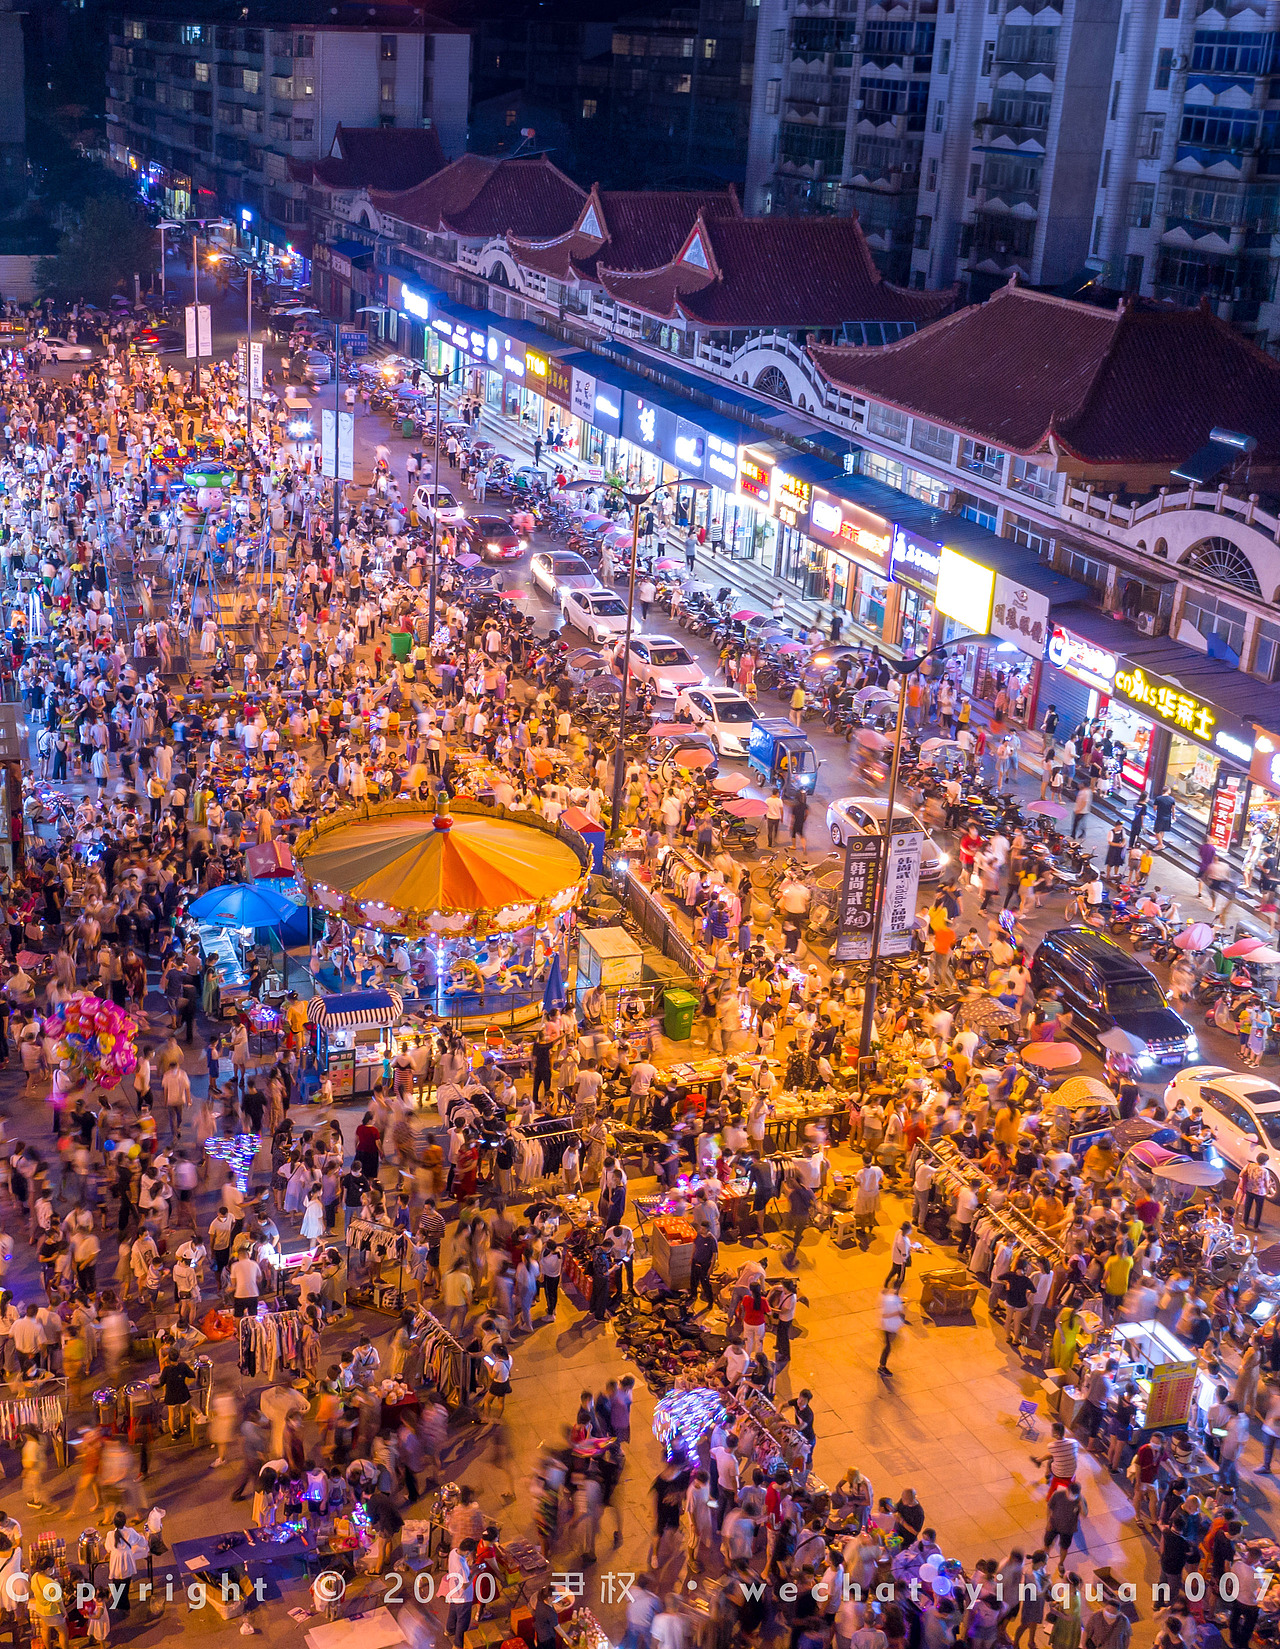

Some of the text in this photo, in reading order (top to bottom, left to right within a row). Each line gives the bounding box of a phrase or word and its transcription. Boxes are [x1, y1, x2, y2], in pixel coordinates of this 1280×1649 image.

[1156, 686, 1216, 741] 华莱士
[846, 861, 867, 905] 韩尚武
